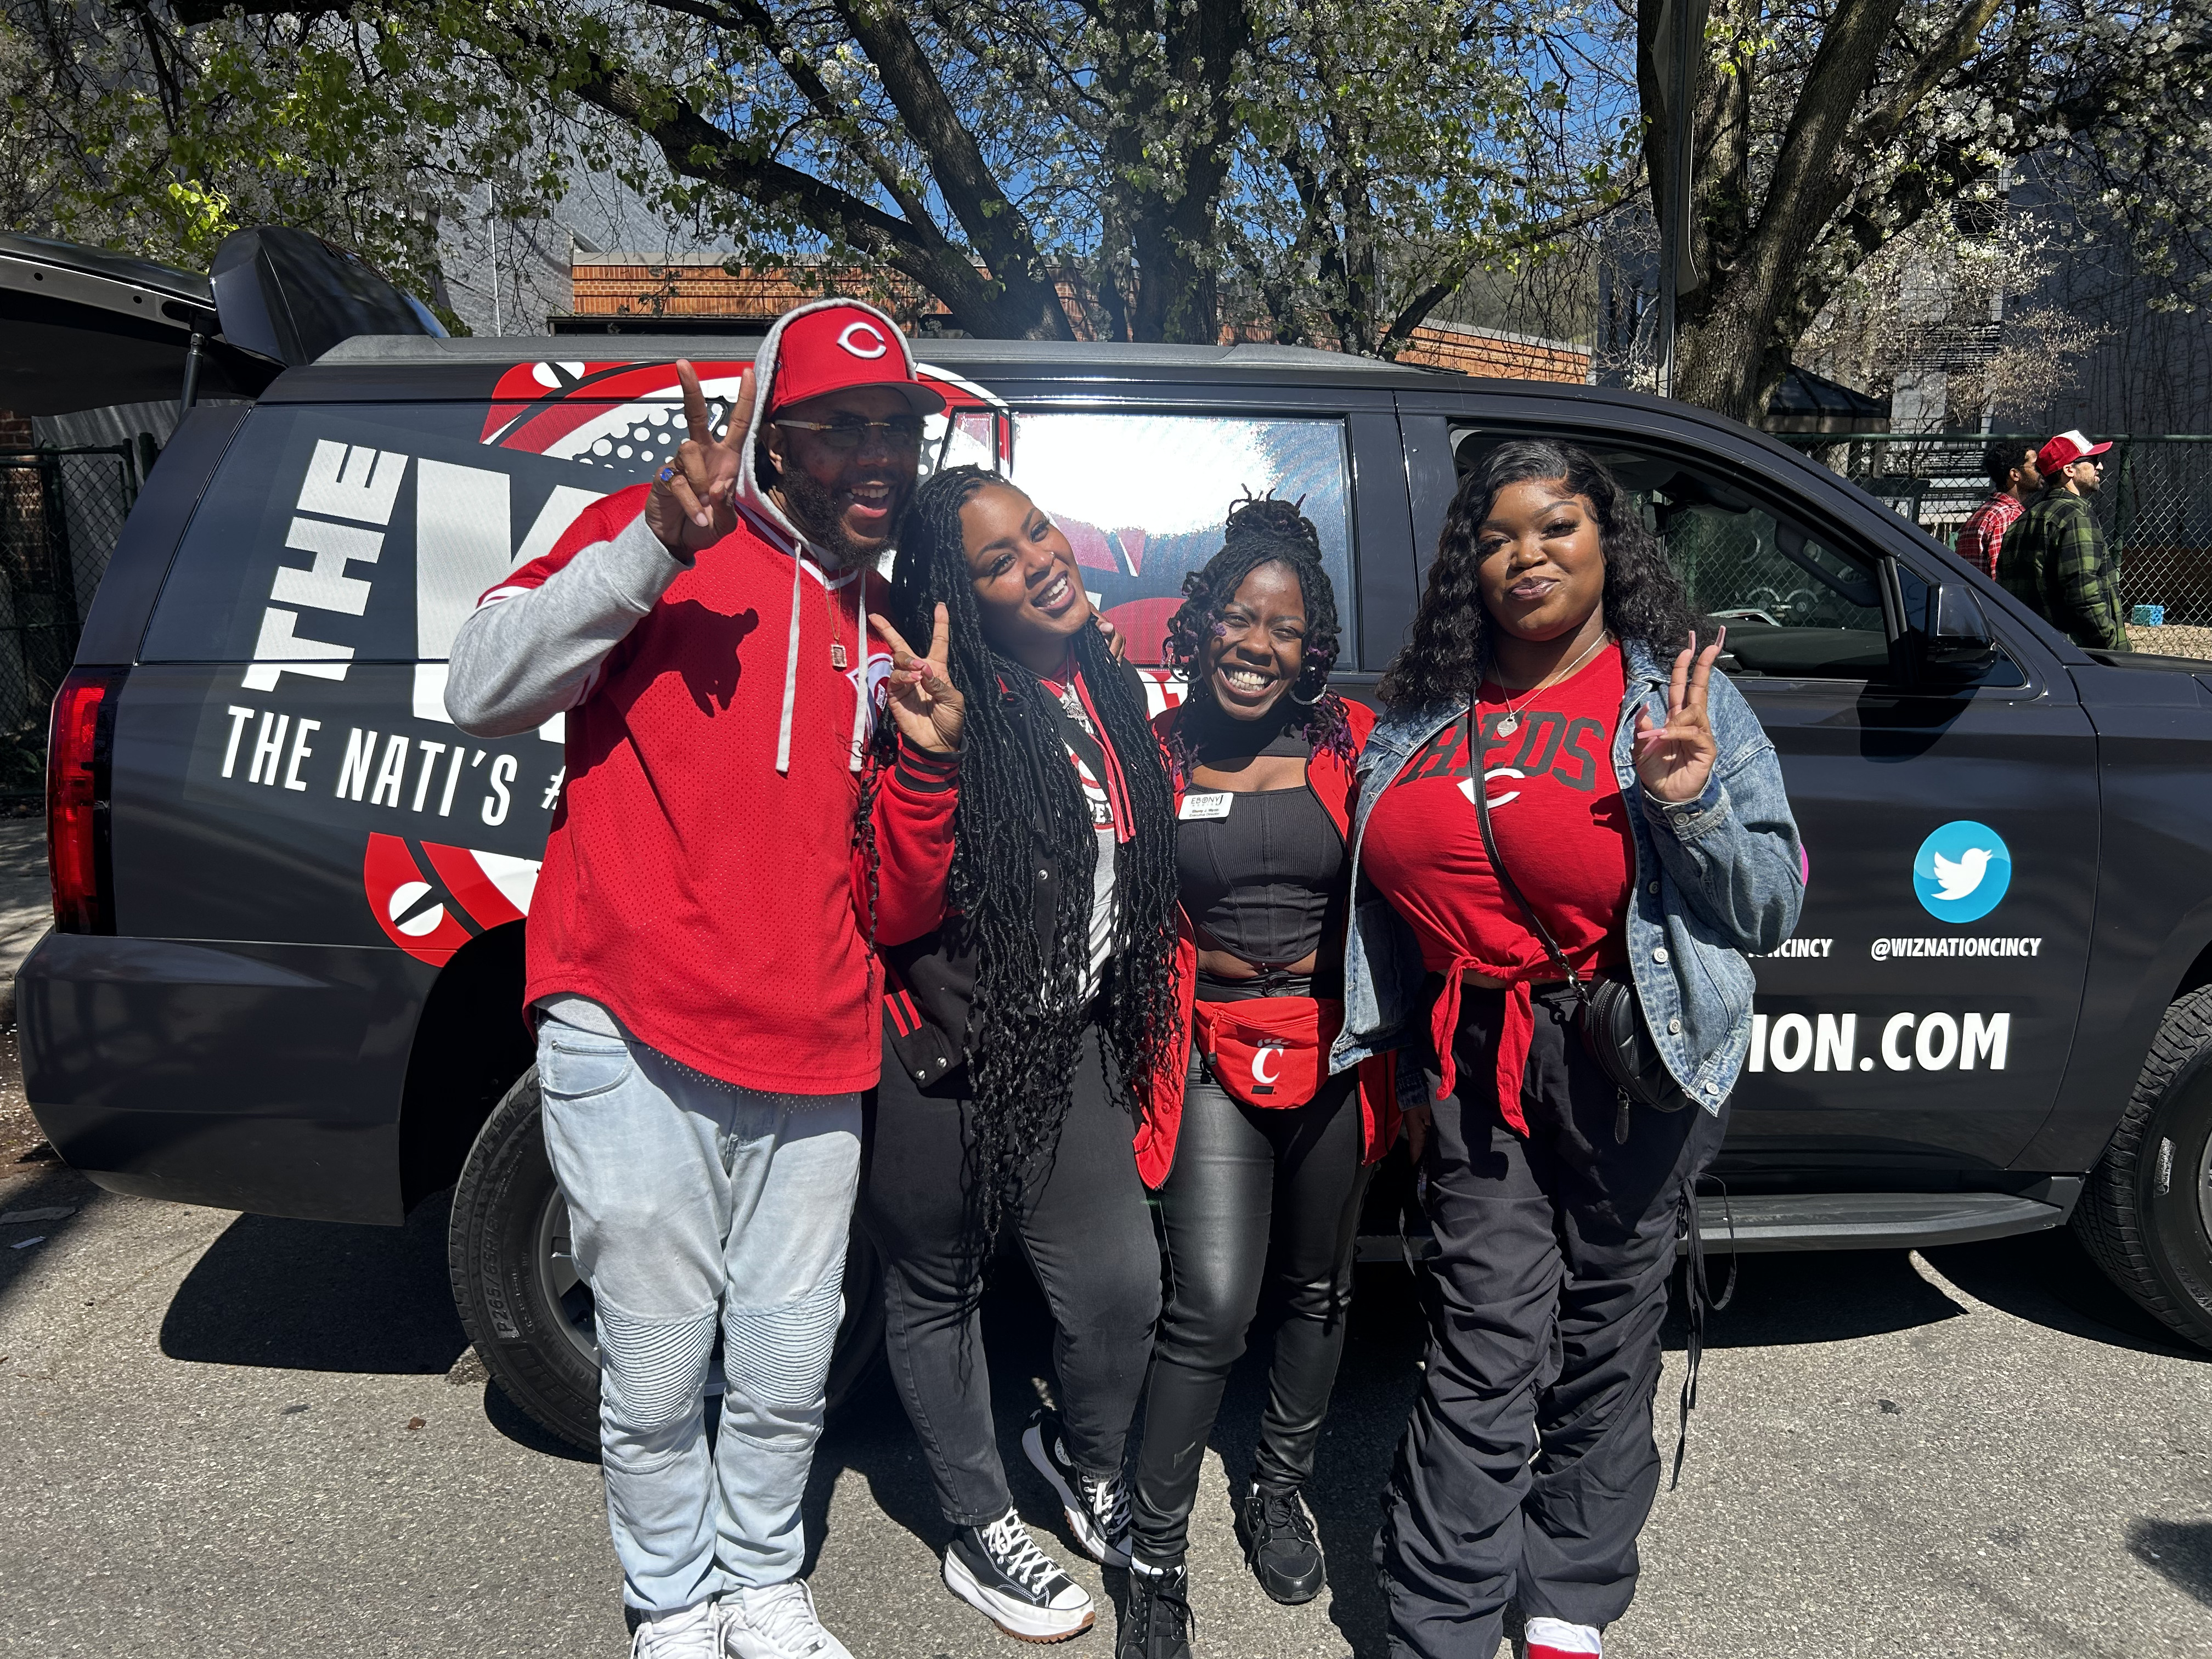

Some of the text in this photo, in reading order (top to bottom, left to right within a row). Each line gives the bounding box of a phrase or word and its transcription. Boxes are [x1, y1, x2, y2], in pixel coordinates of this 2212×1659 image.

[241, 439, 409, 692] THE
[221, 705, 321, 792] THE
[336, 727, 518, 827] NATI'S
[1394, 711, 1605, 792] REDS
[1871, 937, 2041, 961] @WIZNATIONCINCY
